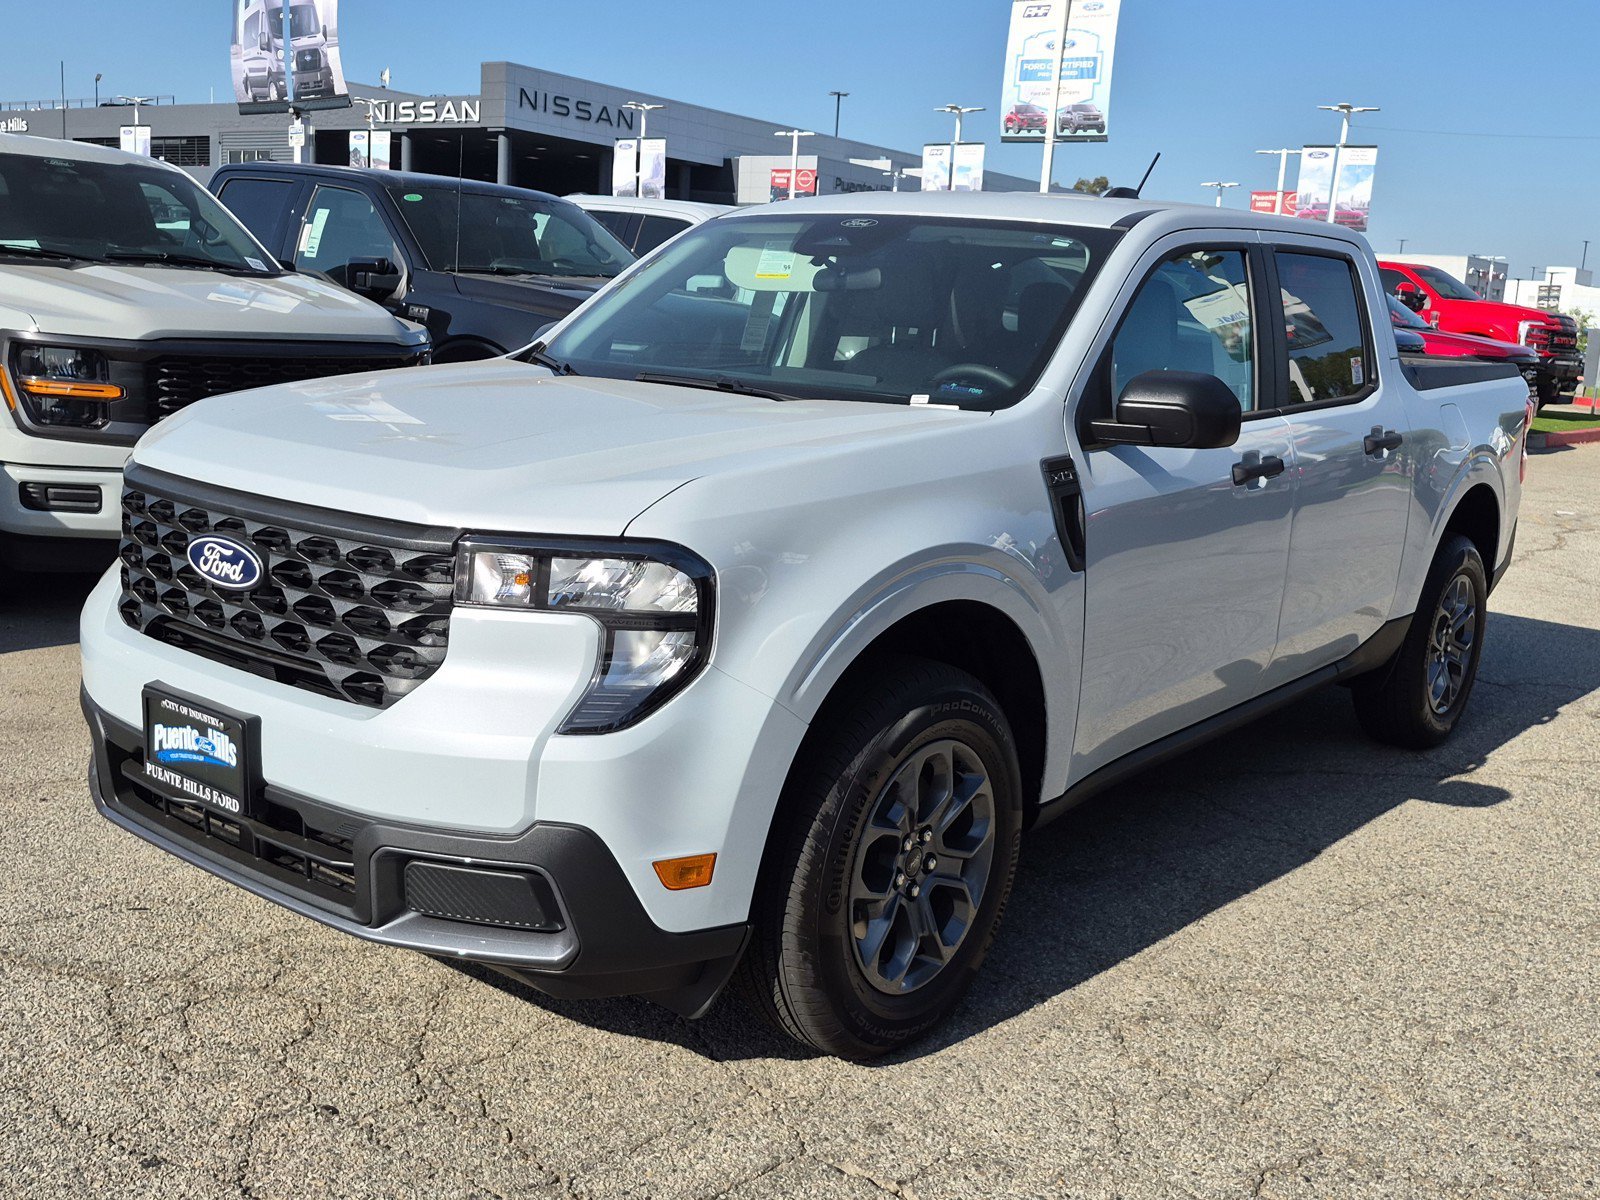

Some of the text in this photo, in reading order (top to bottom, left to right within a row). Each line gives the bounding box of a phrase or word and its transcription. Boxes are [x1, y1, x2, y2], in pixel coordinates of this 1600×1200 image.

[1047, 61, 1094, 70] CRTIFIED
[8, 117, 28, 131] Hills
[370, 100, 480, 123] NISSAN
[519, 87, 634, 131] NISSAN
[200, 542, 245, 581] Ford
[165, 699, 220, 727] CITY OF INDUSTRY
[154, 723, 237, 767] Puente Hills
[146, 762, 240, 813] PUENTE HILLS FORD
